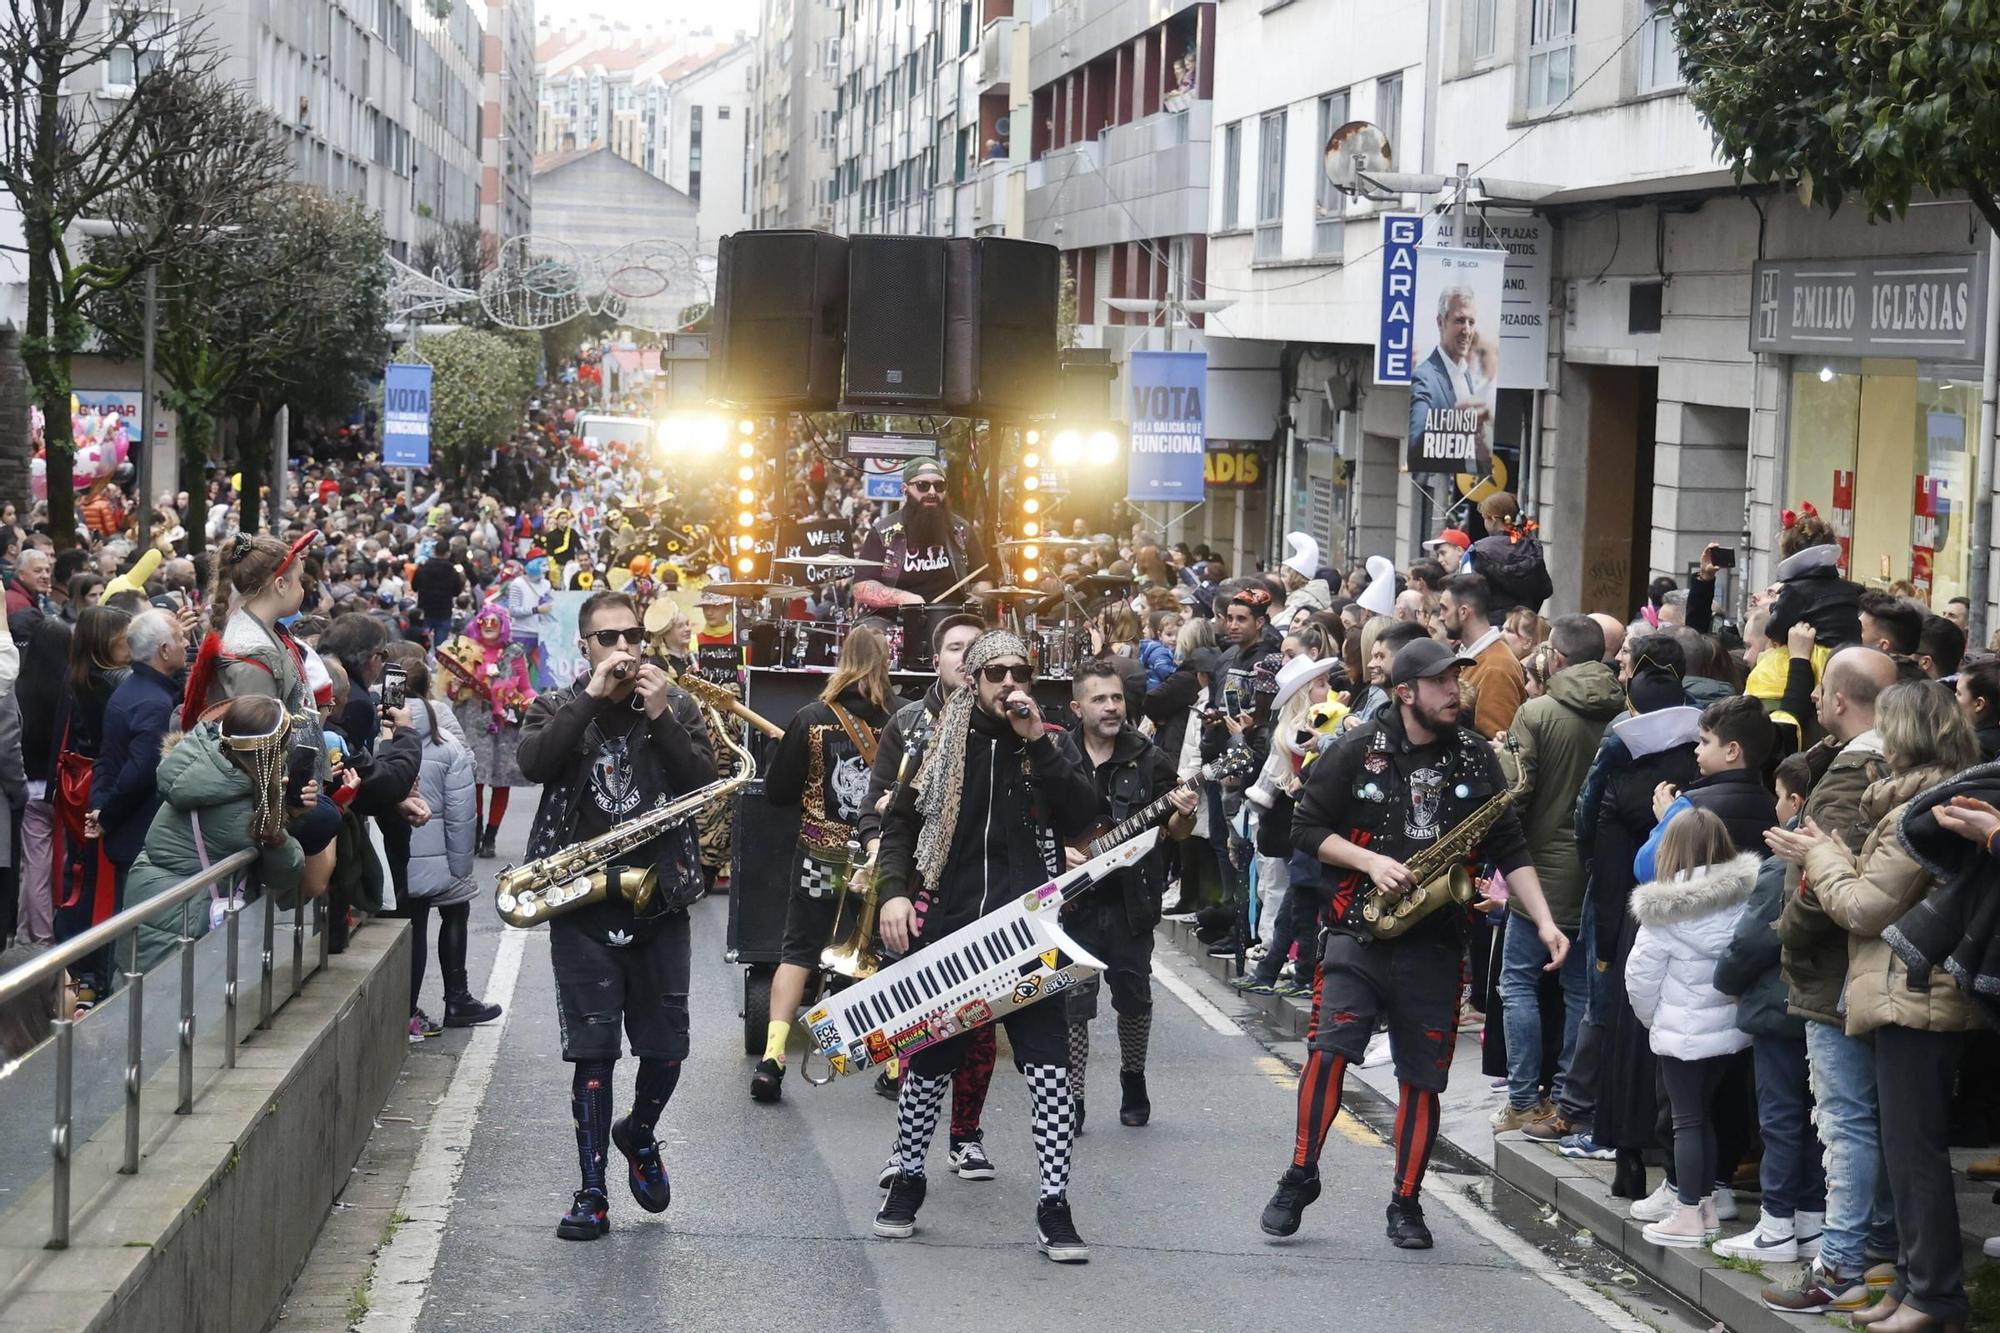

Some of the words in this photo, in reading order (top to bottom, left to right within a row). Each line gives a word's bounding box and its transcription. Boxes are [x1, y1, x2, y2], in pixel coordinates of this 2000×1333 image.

[1500, 227, 1538, 240] PLAZAS
[1387, 221, 1415, 376] GARAJE
[1792, 285, 1856, 330] EMILIO
[1871, 281, 1968, 331] IGLESIAS
[387, 388, 428, 413] VOTA
[1132, 385, 1202, 421] VOTA
[1153, 421, 1186, 434] GALICIA
[1424, 408, 1478, 433] ALFONSO
[1131, 434, 1202, 454] FUNCIONA
[1423, 432, 1476, 460] RUEDA
[815, 1023, 838, 1041] FCK
[820, 1032, 842, 1050] CPS
